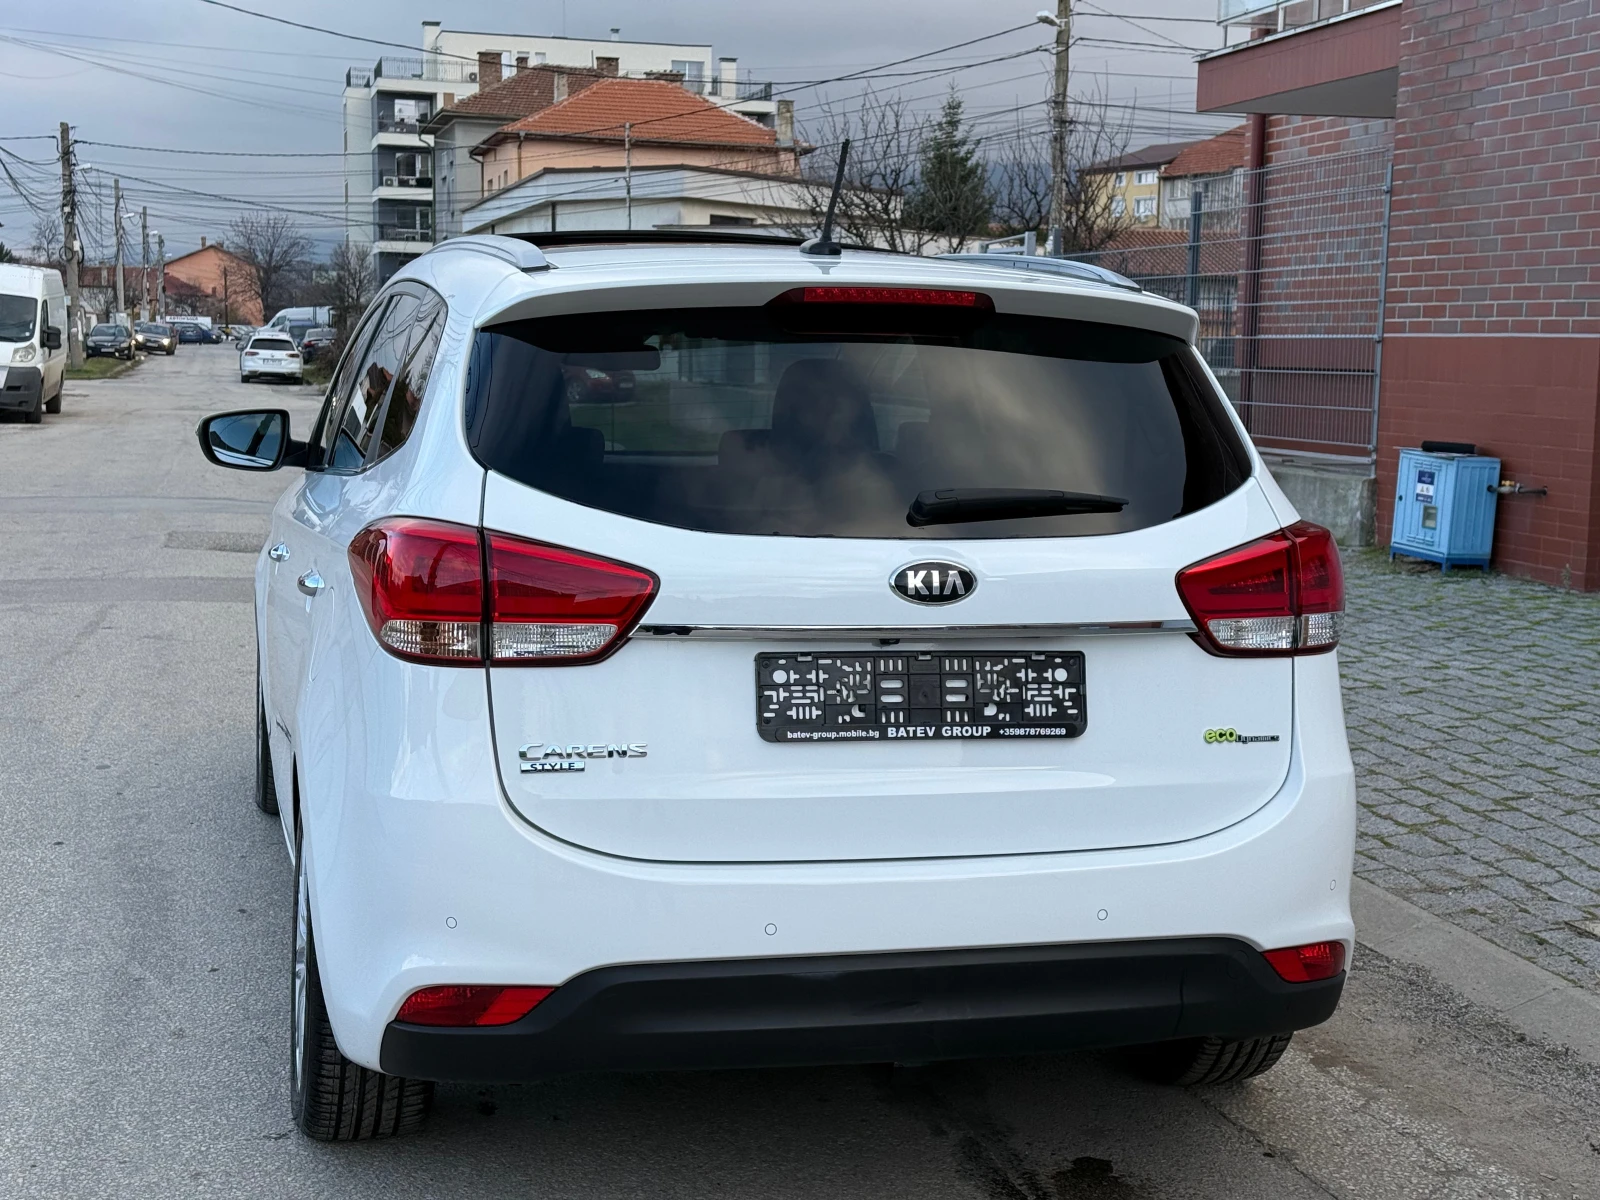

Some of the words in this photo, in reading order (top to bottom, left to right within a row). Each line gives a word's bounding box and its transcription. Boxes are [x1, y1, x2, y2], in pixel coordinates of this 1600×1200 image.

[906, 570, 966, 595] KIA
[787, 730, 880, 739] batev-group.mobile.bg
[887, 727, 936, 738] BATEV
[941, 726, 992, 737] GROUP
[999, 727, 1067, 736] +359878769269
[518, 743, 648, 761] CARENS
[529, 762, 576, 771] STYLE
